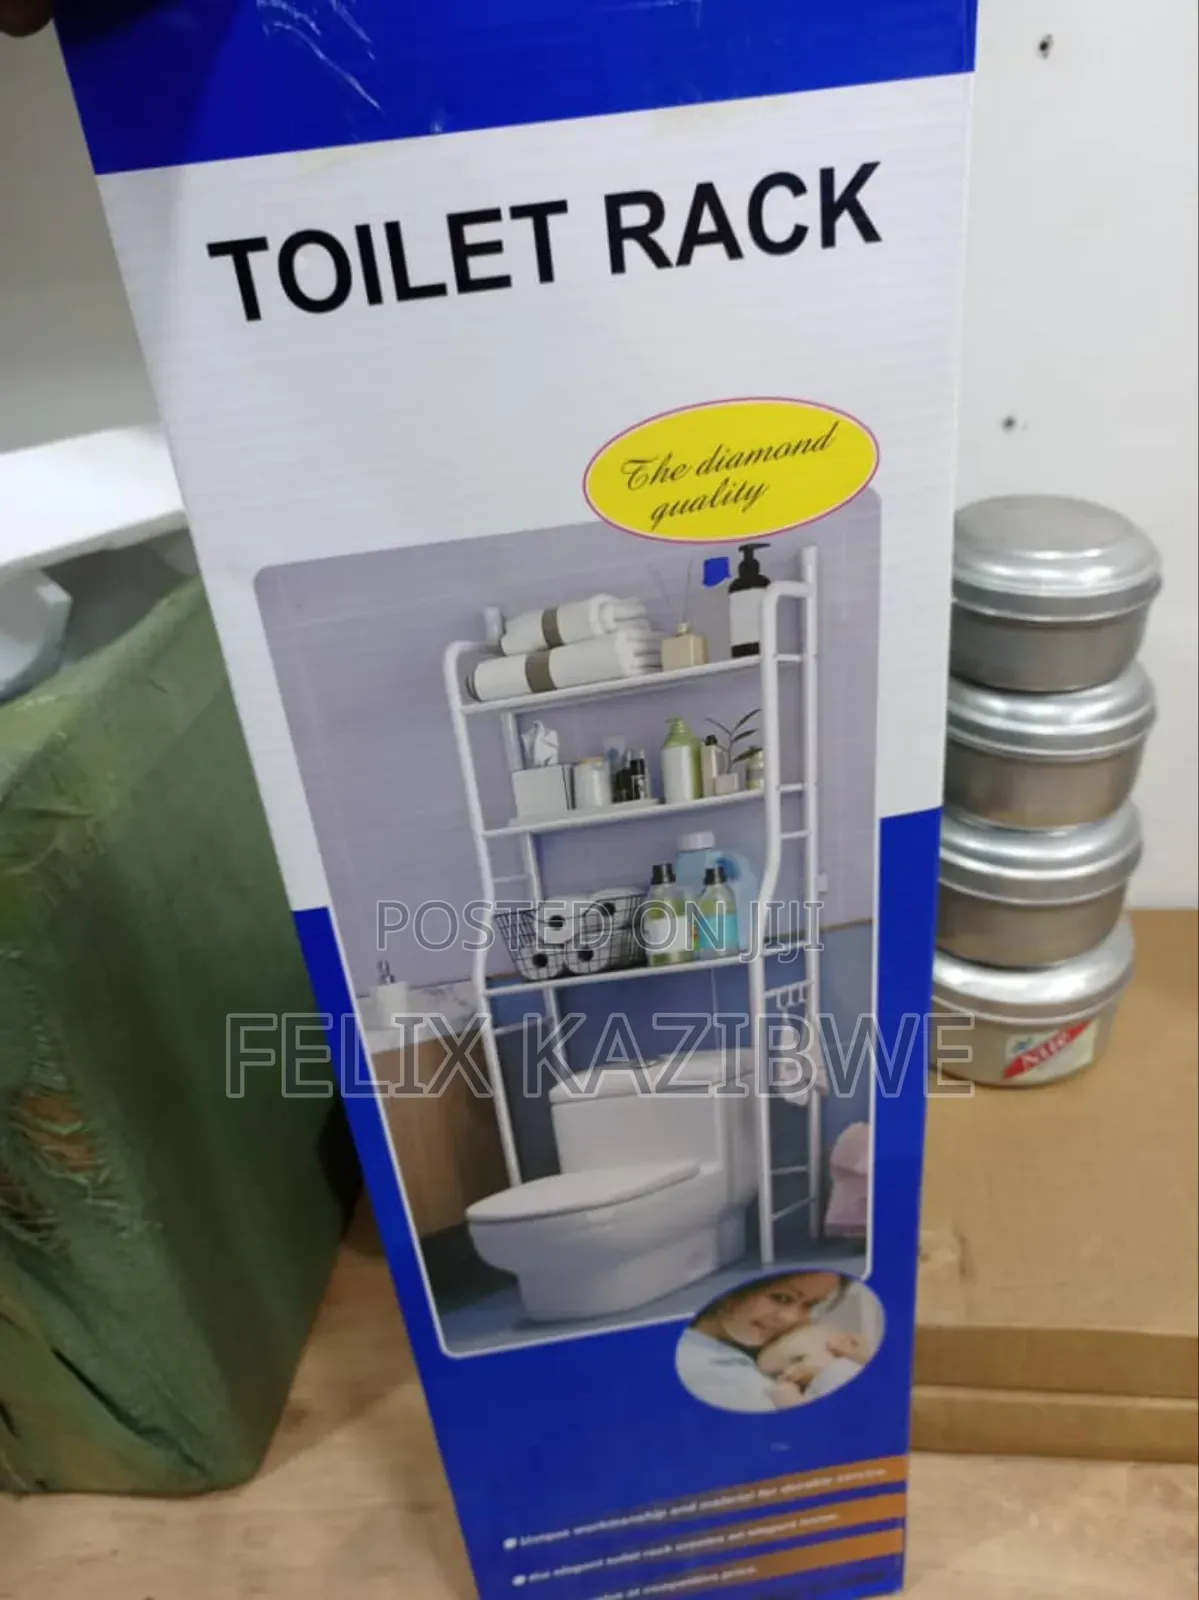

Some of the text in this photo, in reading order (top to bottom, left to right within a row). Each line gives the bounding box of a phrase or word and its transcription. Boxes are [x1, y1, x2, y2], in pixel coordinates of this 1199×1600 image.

[207, 161, 883, 322] TOILET RACK
[619, 420, 840, 492] The diamond
[650, 476, 769, 531] quality
